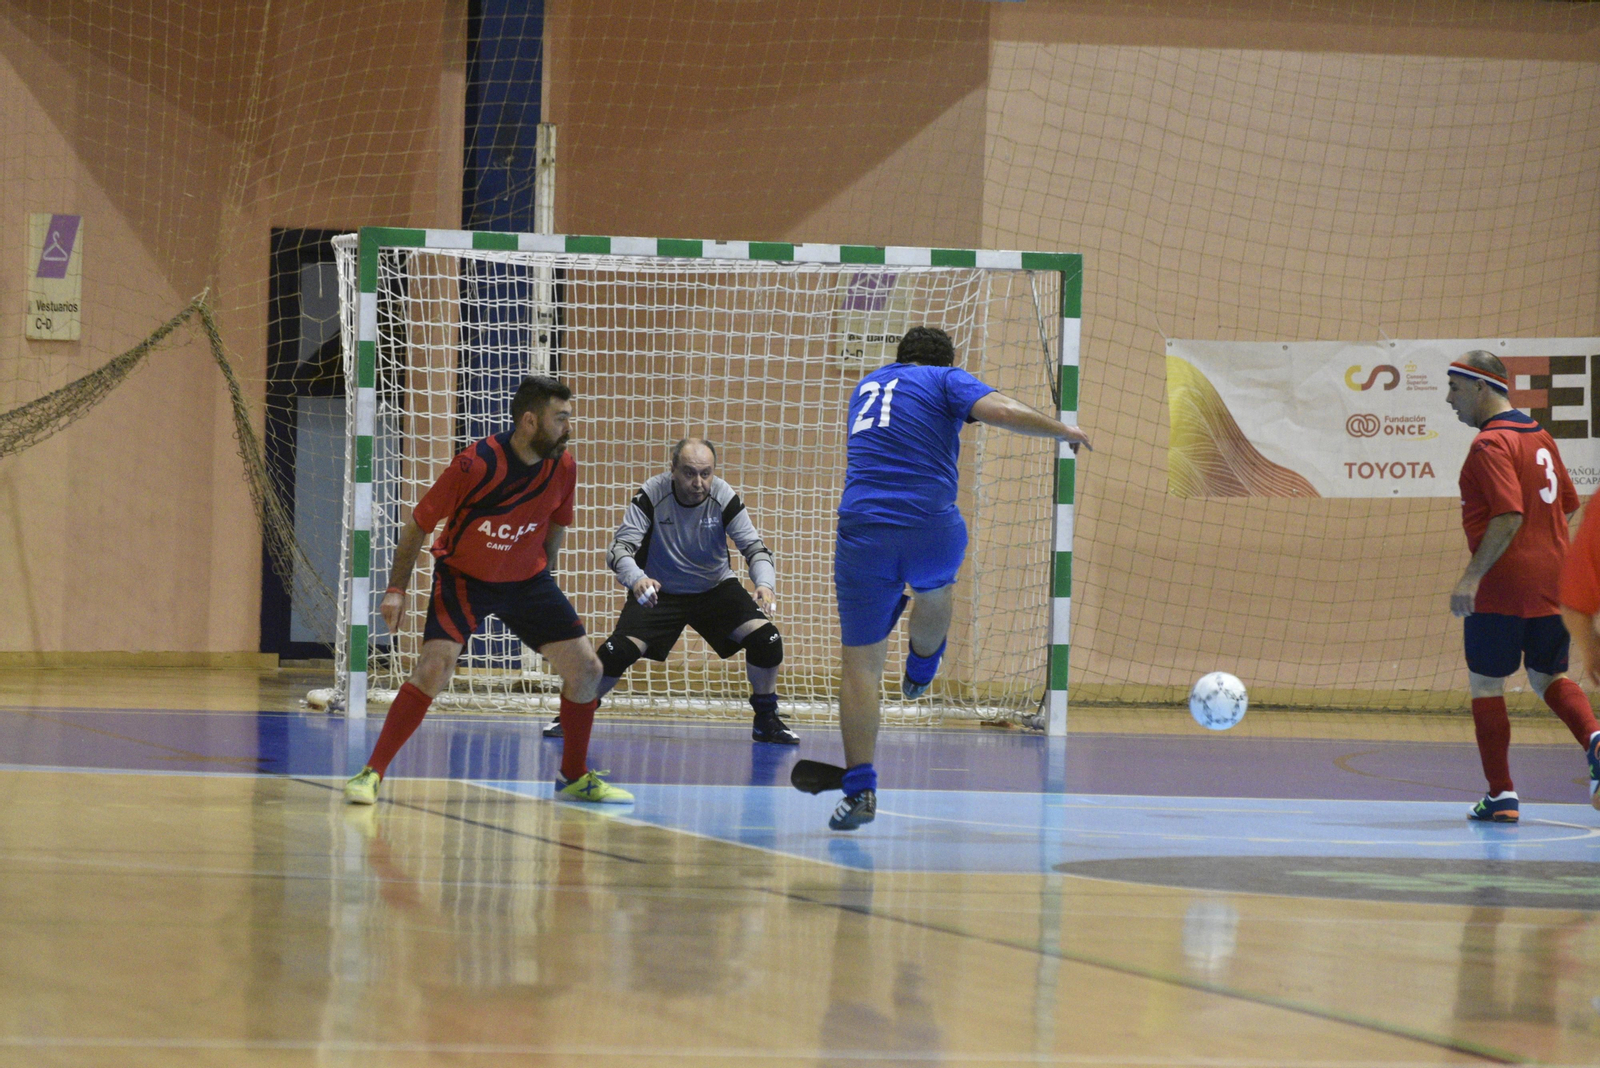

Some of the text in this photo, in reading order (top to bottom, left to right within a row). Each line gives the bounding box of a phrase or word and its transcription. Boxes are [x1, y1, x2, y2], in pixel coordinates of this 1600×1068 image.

[36, 300, 79, 312] Vestuarios
[36, 318, 52, 330] C-D
[851, 377, 899, 435] 21
[1384, 415, 1426, 423] Fundación
[1383, 424, 1426, 436] ONCE
[1344, 461, 1436, 479] TOYOTA
[1536, 447, 1558, 505] 3
